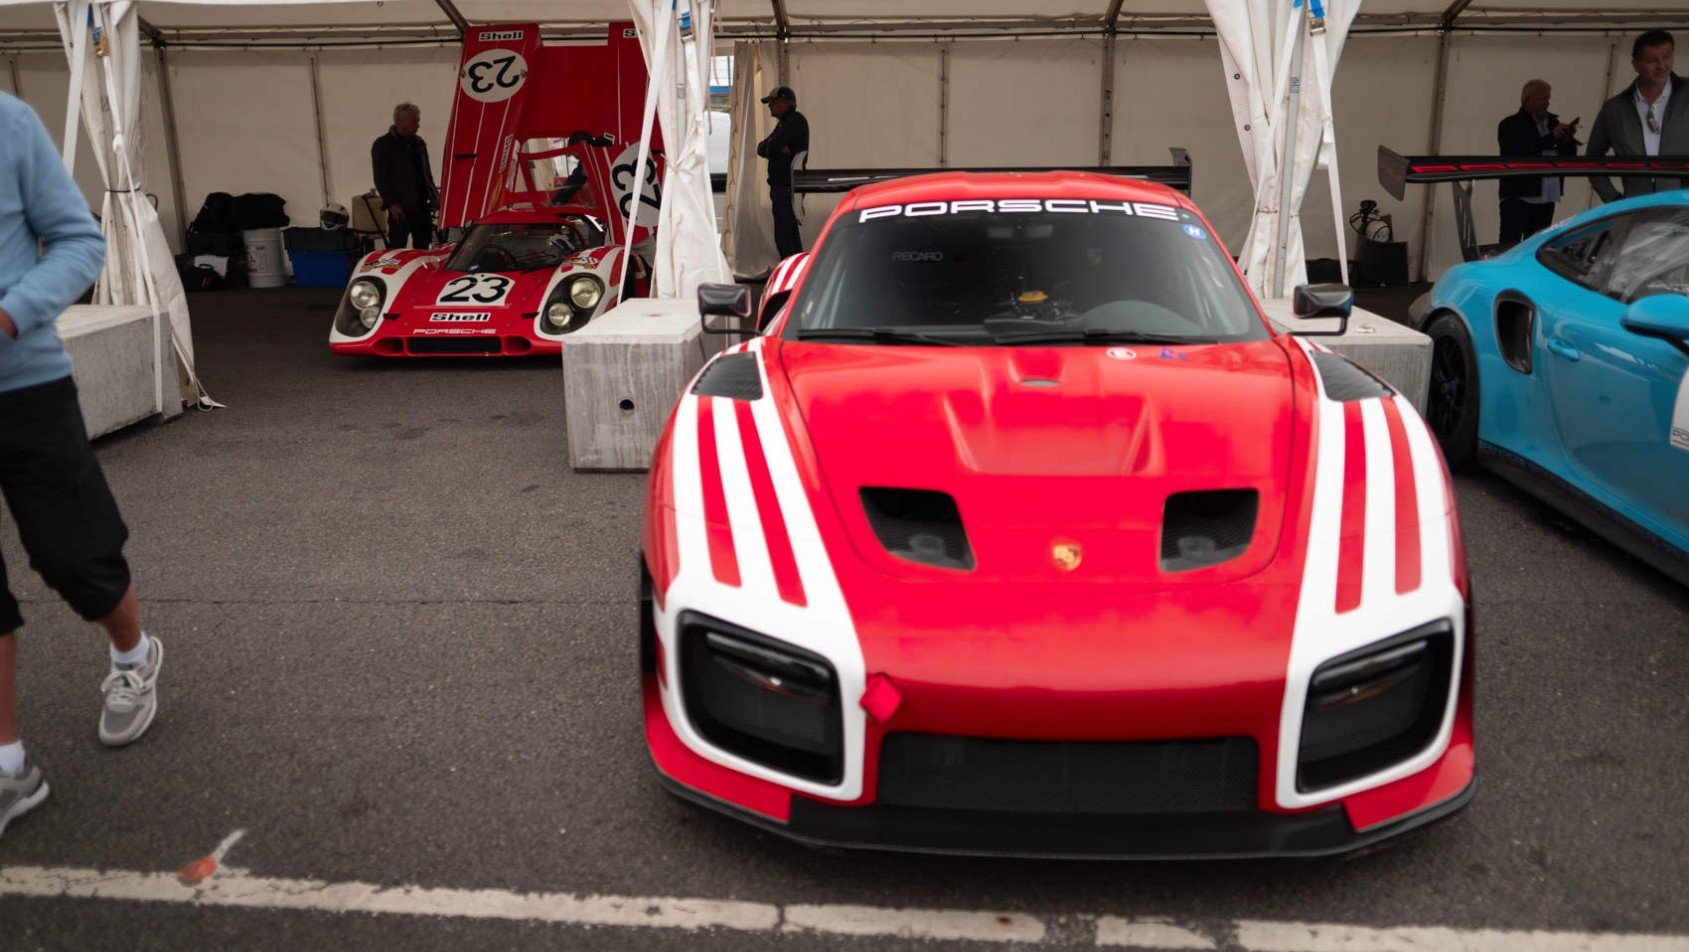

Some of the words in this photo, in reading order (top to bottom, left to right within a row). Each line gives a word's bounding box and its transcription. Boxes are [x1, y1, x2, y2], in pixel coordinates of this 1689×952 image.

[480, 32, 522, 40] Shell
[468, 56, 520, 93] 23
[858, 199, 1180, 223] PORSCHE
[439, 276, 510, 303] 23
[432, 313, 488, 321] Shell
